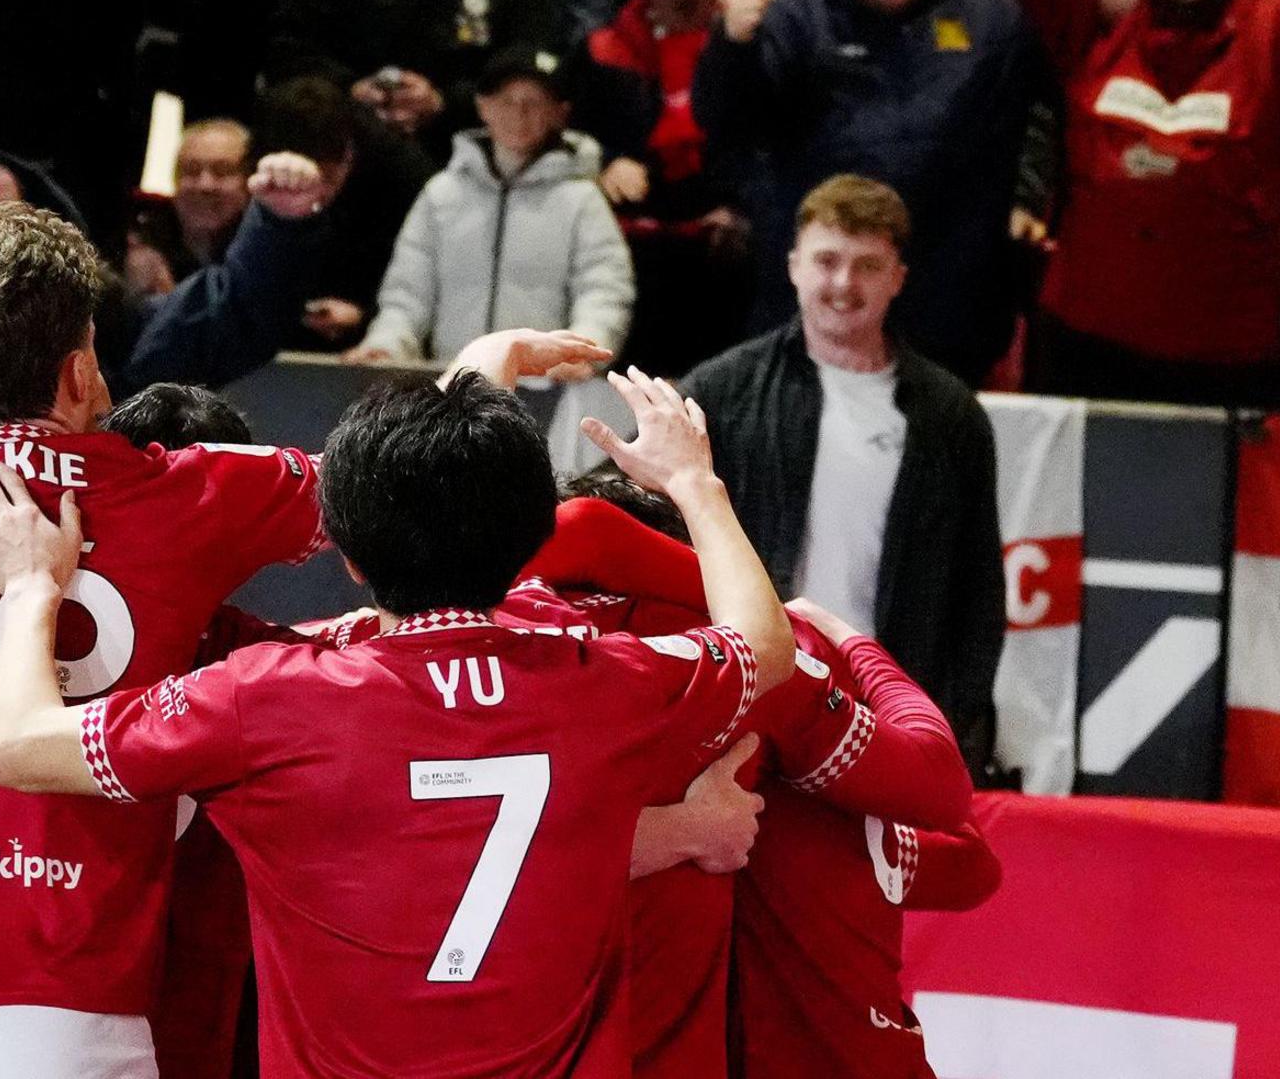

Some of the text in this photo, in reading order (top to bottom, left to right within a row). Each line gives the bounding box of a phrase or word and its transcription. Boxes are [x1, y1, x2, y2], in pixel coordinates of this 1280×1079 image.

[1003, 544, 1051, 624] C
[426, 655, 505, 709] YU
[408, 753, 551, 983] 7
[448, 967, 464, 976] EFL
